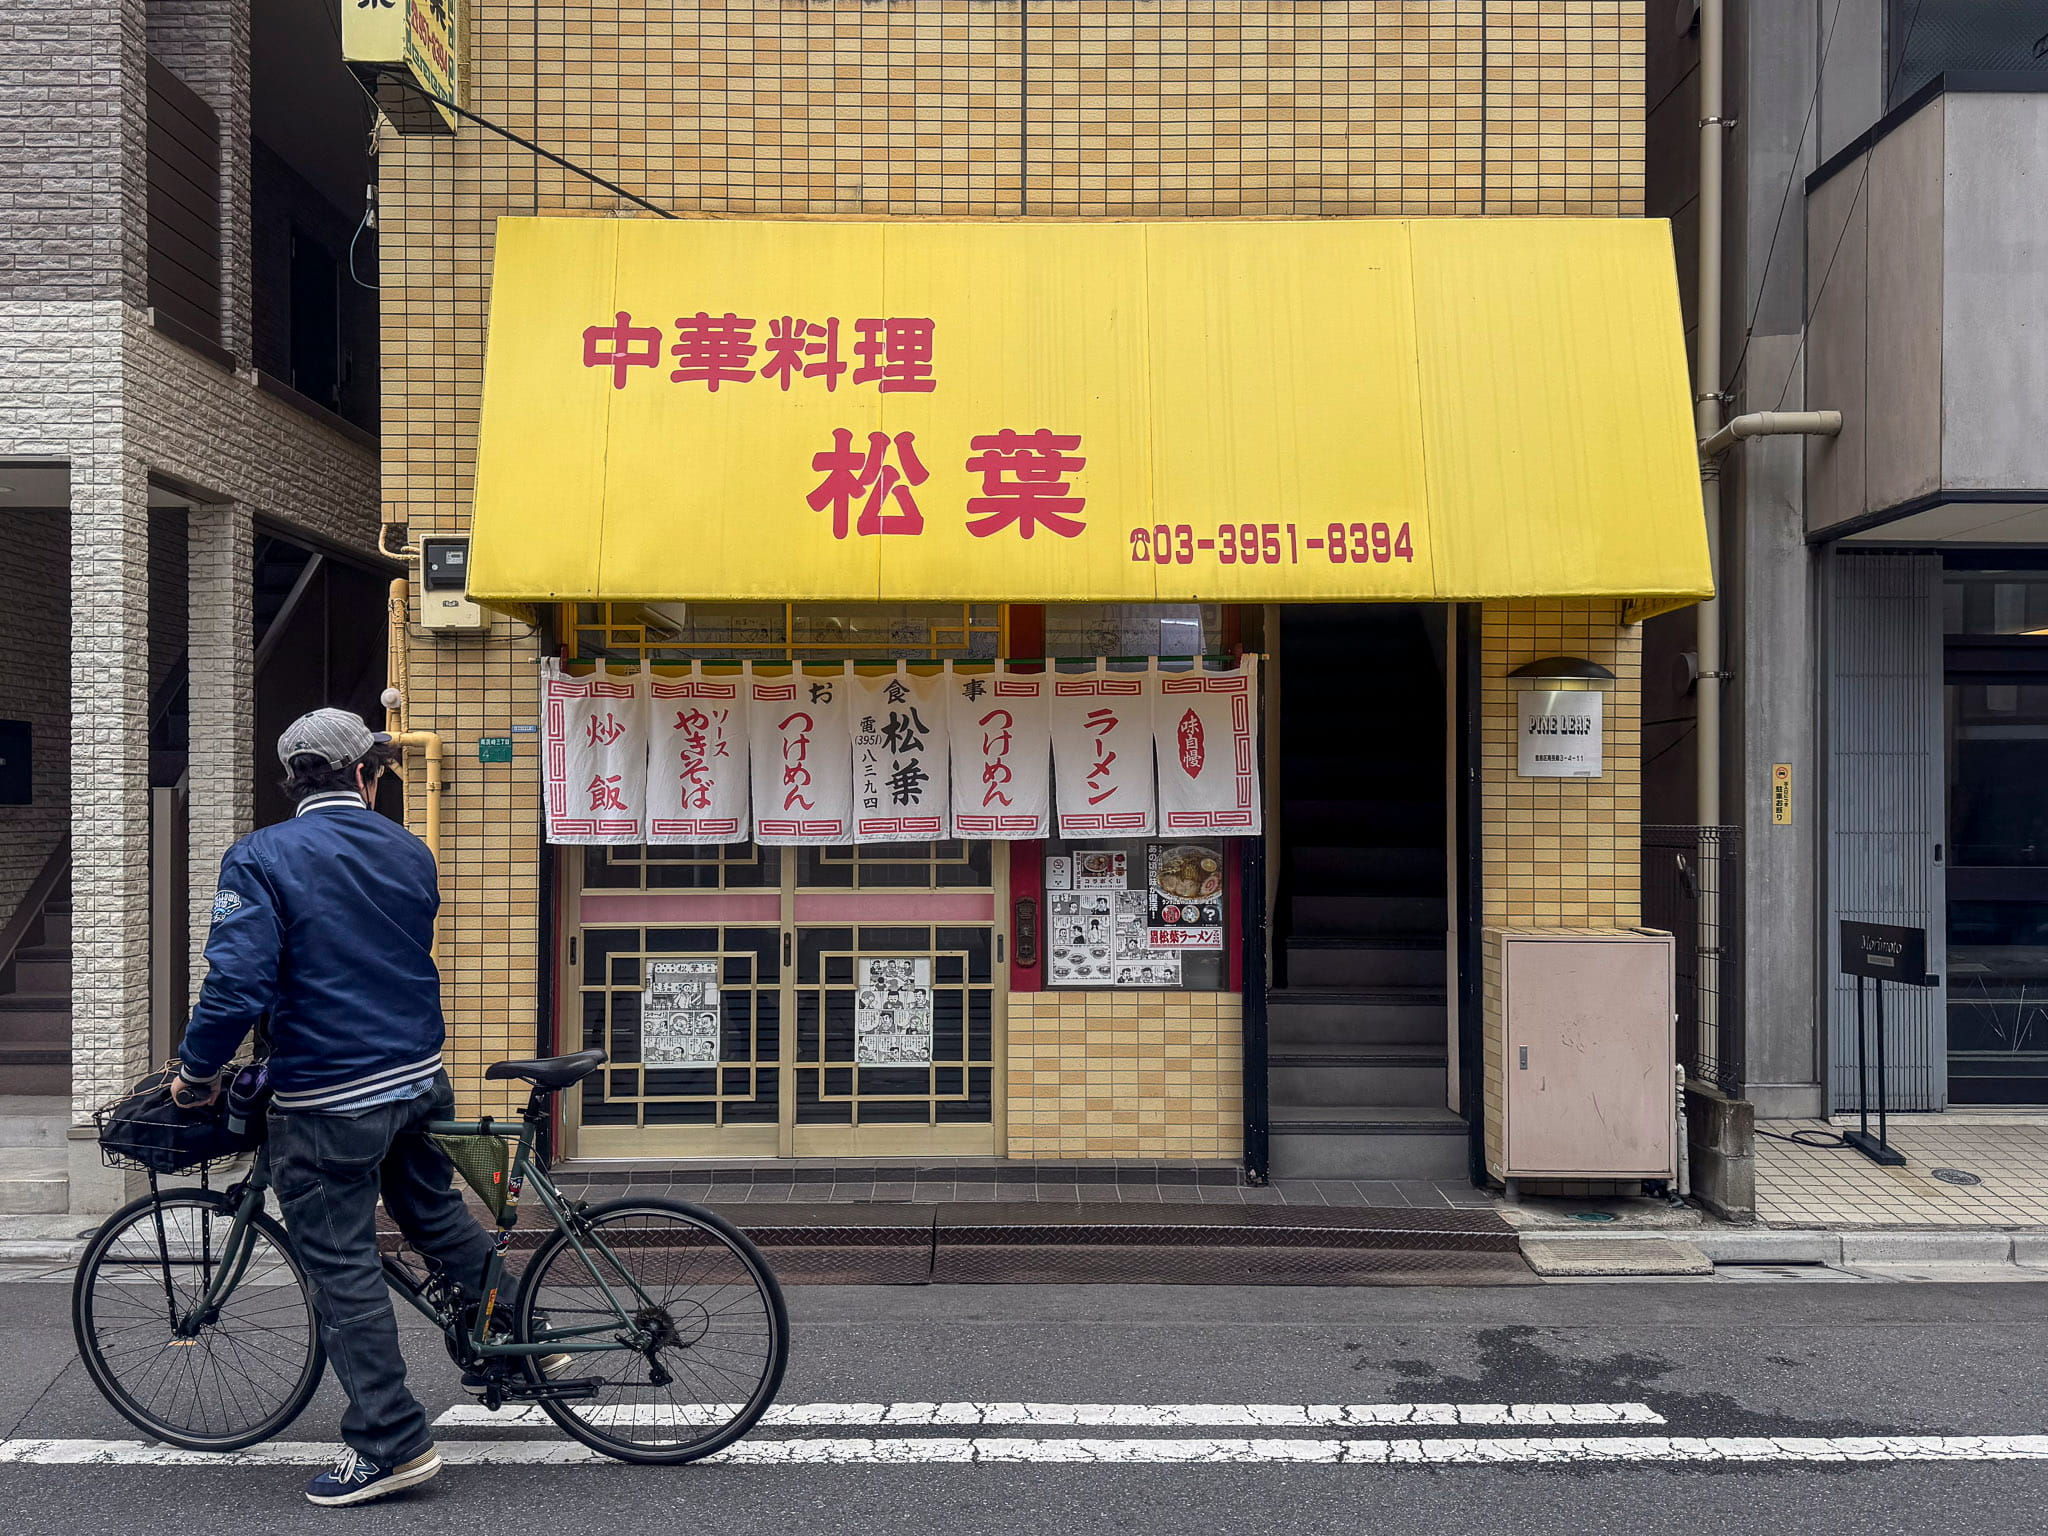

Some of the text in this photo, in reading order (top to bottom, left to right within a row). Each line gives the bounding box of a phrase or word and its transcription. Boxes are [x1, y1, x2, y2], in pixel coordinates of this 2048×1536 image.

[583, 311, 936, 393] 中華料理
[806, 427, 1087, 539] 松葉
[1153, 522, 1414, 565] 03-3951-8394
[586, 711, 629, 812] 炒飯
[674, 707, 714, 810] やきそば
[713, 708, 730, 758] ソース
[777, 711, 816, 811] つけめん
[881, 706, 930, 807] 松葉
[978, 709, 1014, 808] つけめん
[1083, 708, 1120, 806] ラーメン
[1180, 714, 1203, 769] 味自慢
[1860, 935, 1903, 954] Morimoto
